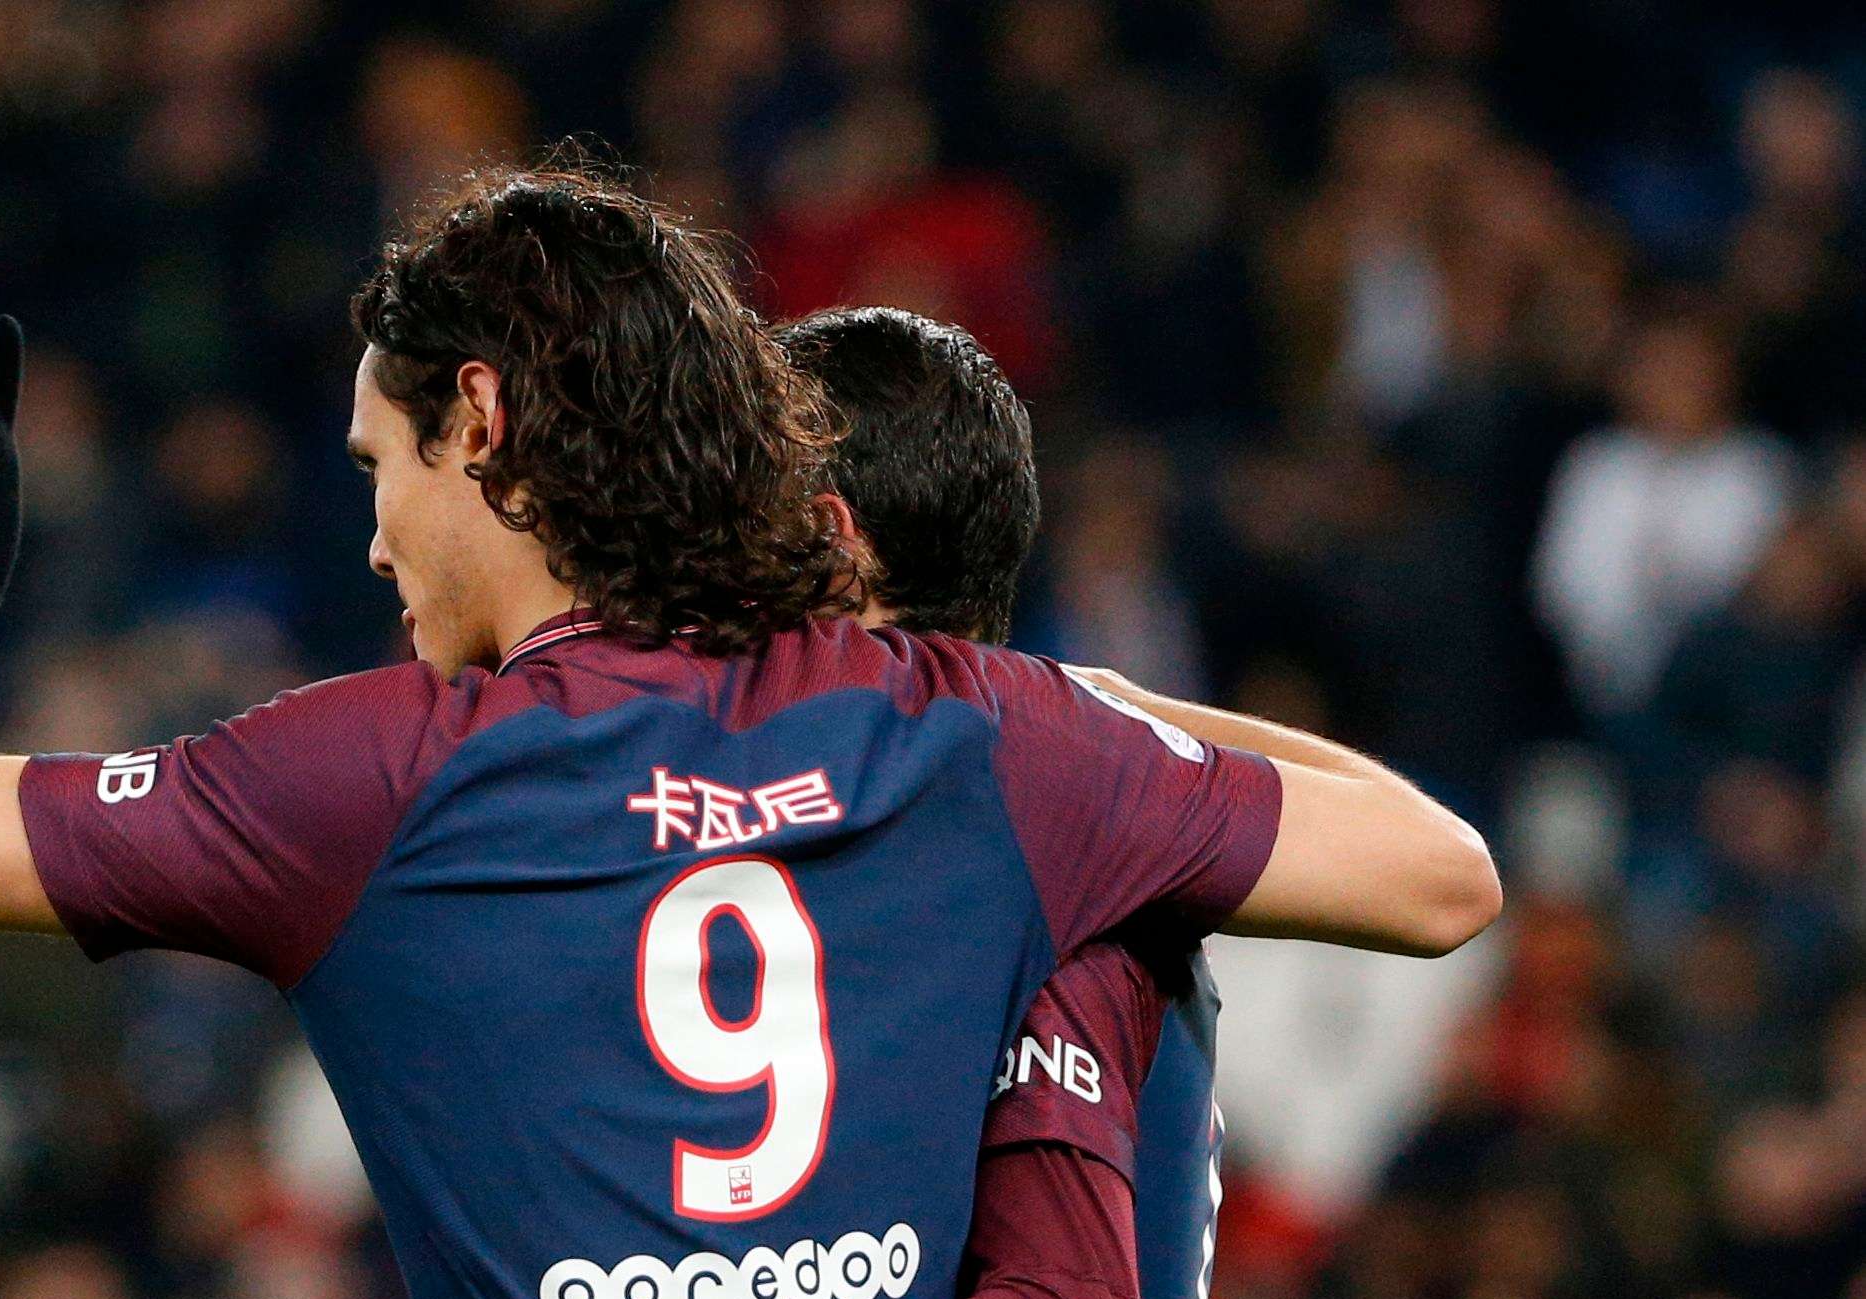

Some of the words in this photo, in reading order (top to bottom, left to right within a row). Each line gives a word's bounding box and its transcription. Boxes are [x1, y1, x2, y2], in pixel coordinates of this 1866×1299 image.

[628, 766, 842, 849] 卡瓦尼
[638, 855, 836, 1222] 9
[731, 1190, 751, 1201] LFP
